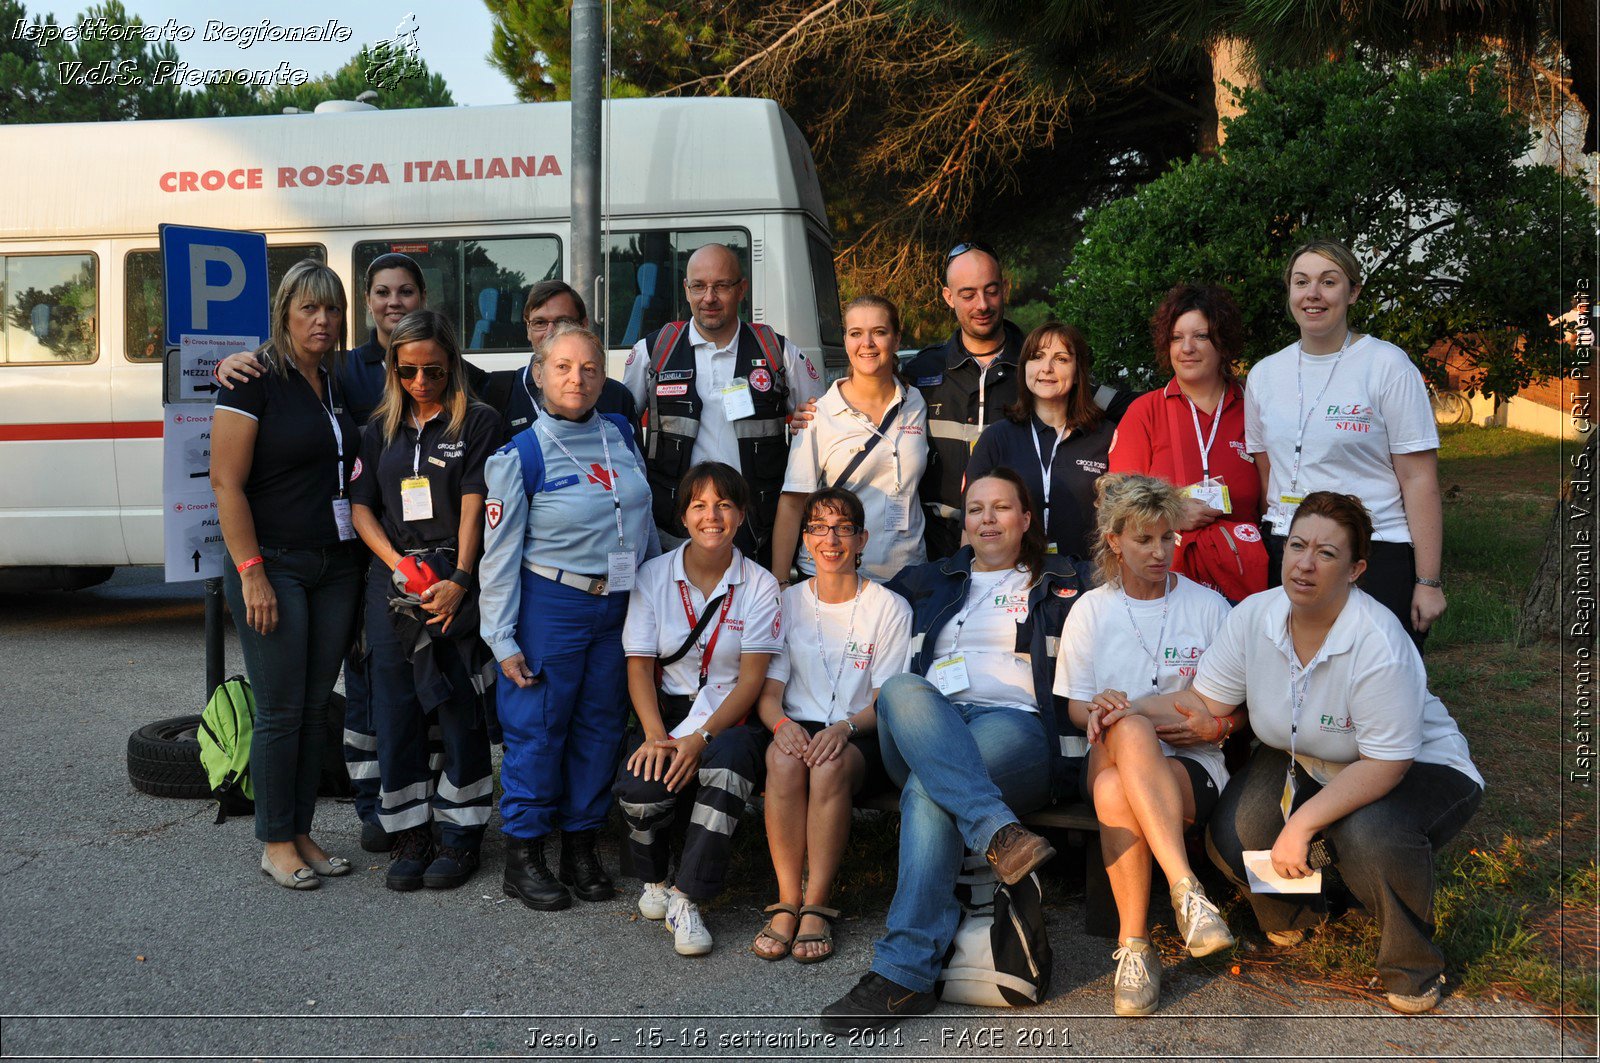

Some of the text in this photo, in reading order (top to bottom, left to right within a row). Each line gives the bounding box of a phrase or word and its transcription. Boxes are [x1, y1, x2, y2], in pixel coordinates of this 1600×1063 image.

[159, 155, 562, 193] CROCE ROSSA ITALIANA
[189, 244, 246, 330] P
[1327, 404, 1361, 415] FACE
[1336, 422, 1370, 433] STAFF
[1164, 646, 1198, 659] FACE
[1178, 666, 1197, 677] STA
[1320, 714, 1352, 728] FACE
